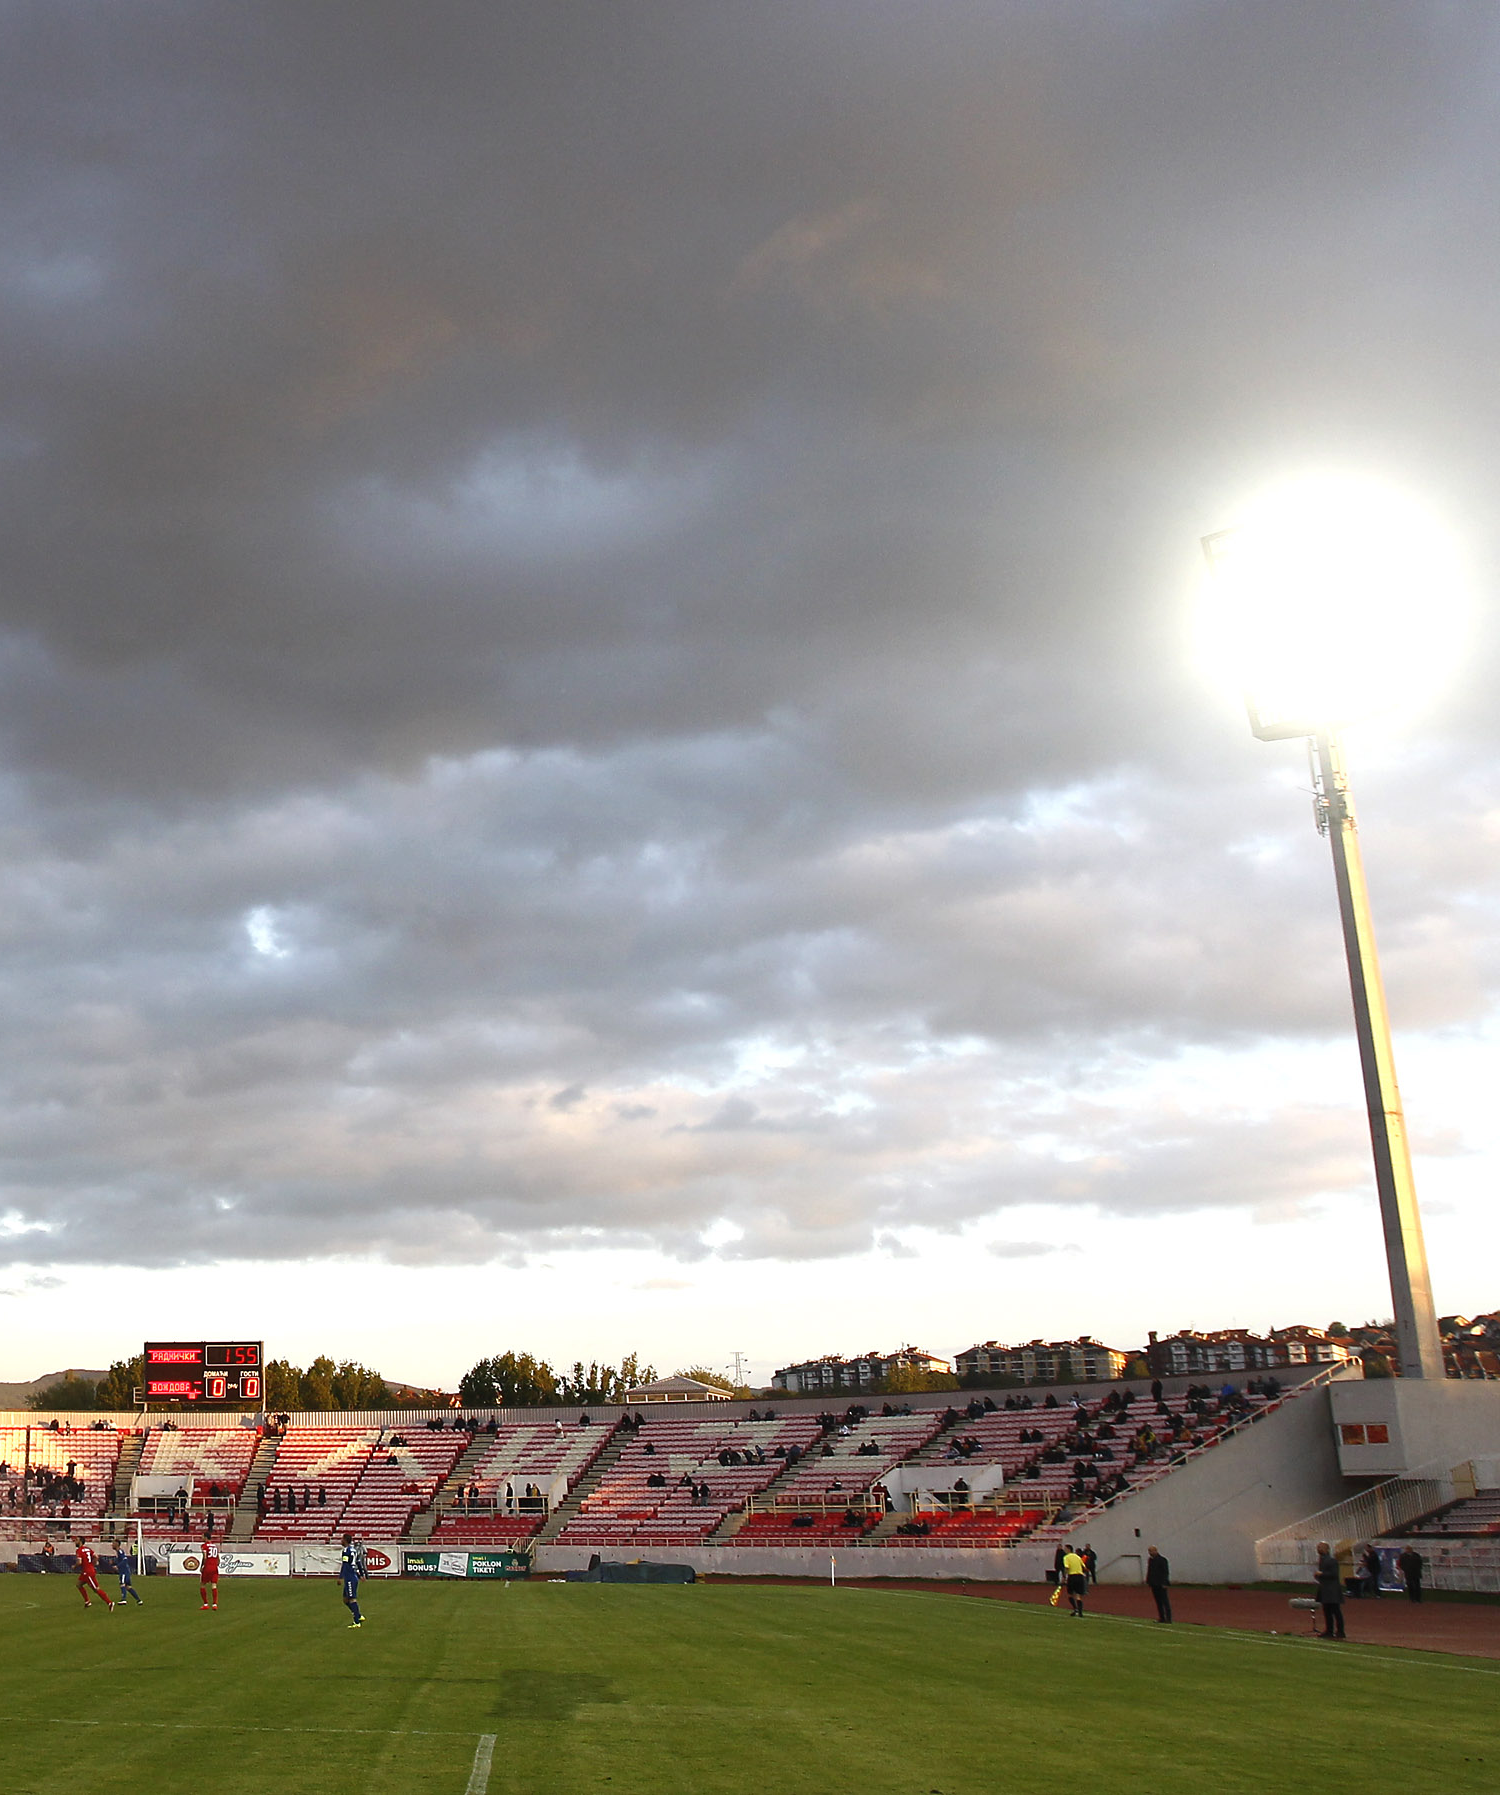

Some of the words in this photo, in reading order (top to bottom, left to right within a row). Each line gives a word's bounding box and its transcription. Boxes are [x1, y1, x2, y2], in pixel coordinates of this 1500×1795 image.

[213, 1379, 224, 1396] 0
[246, 1379, 258, 1396] 0
[207, 1546, 218, 1558] 30
[407, 1564, 437, 1572] BONUS?
[472, 1560, 502, 1568] POKLON
